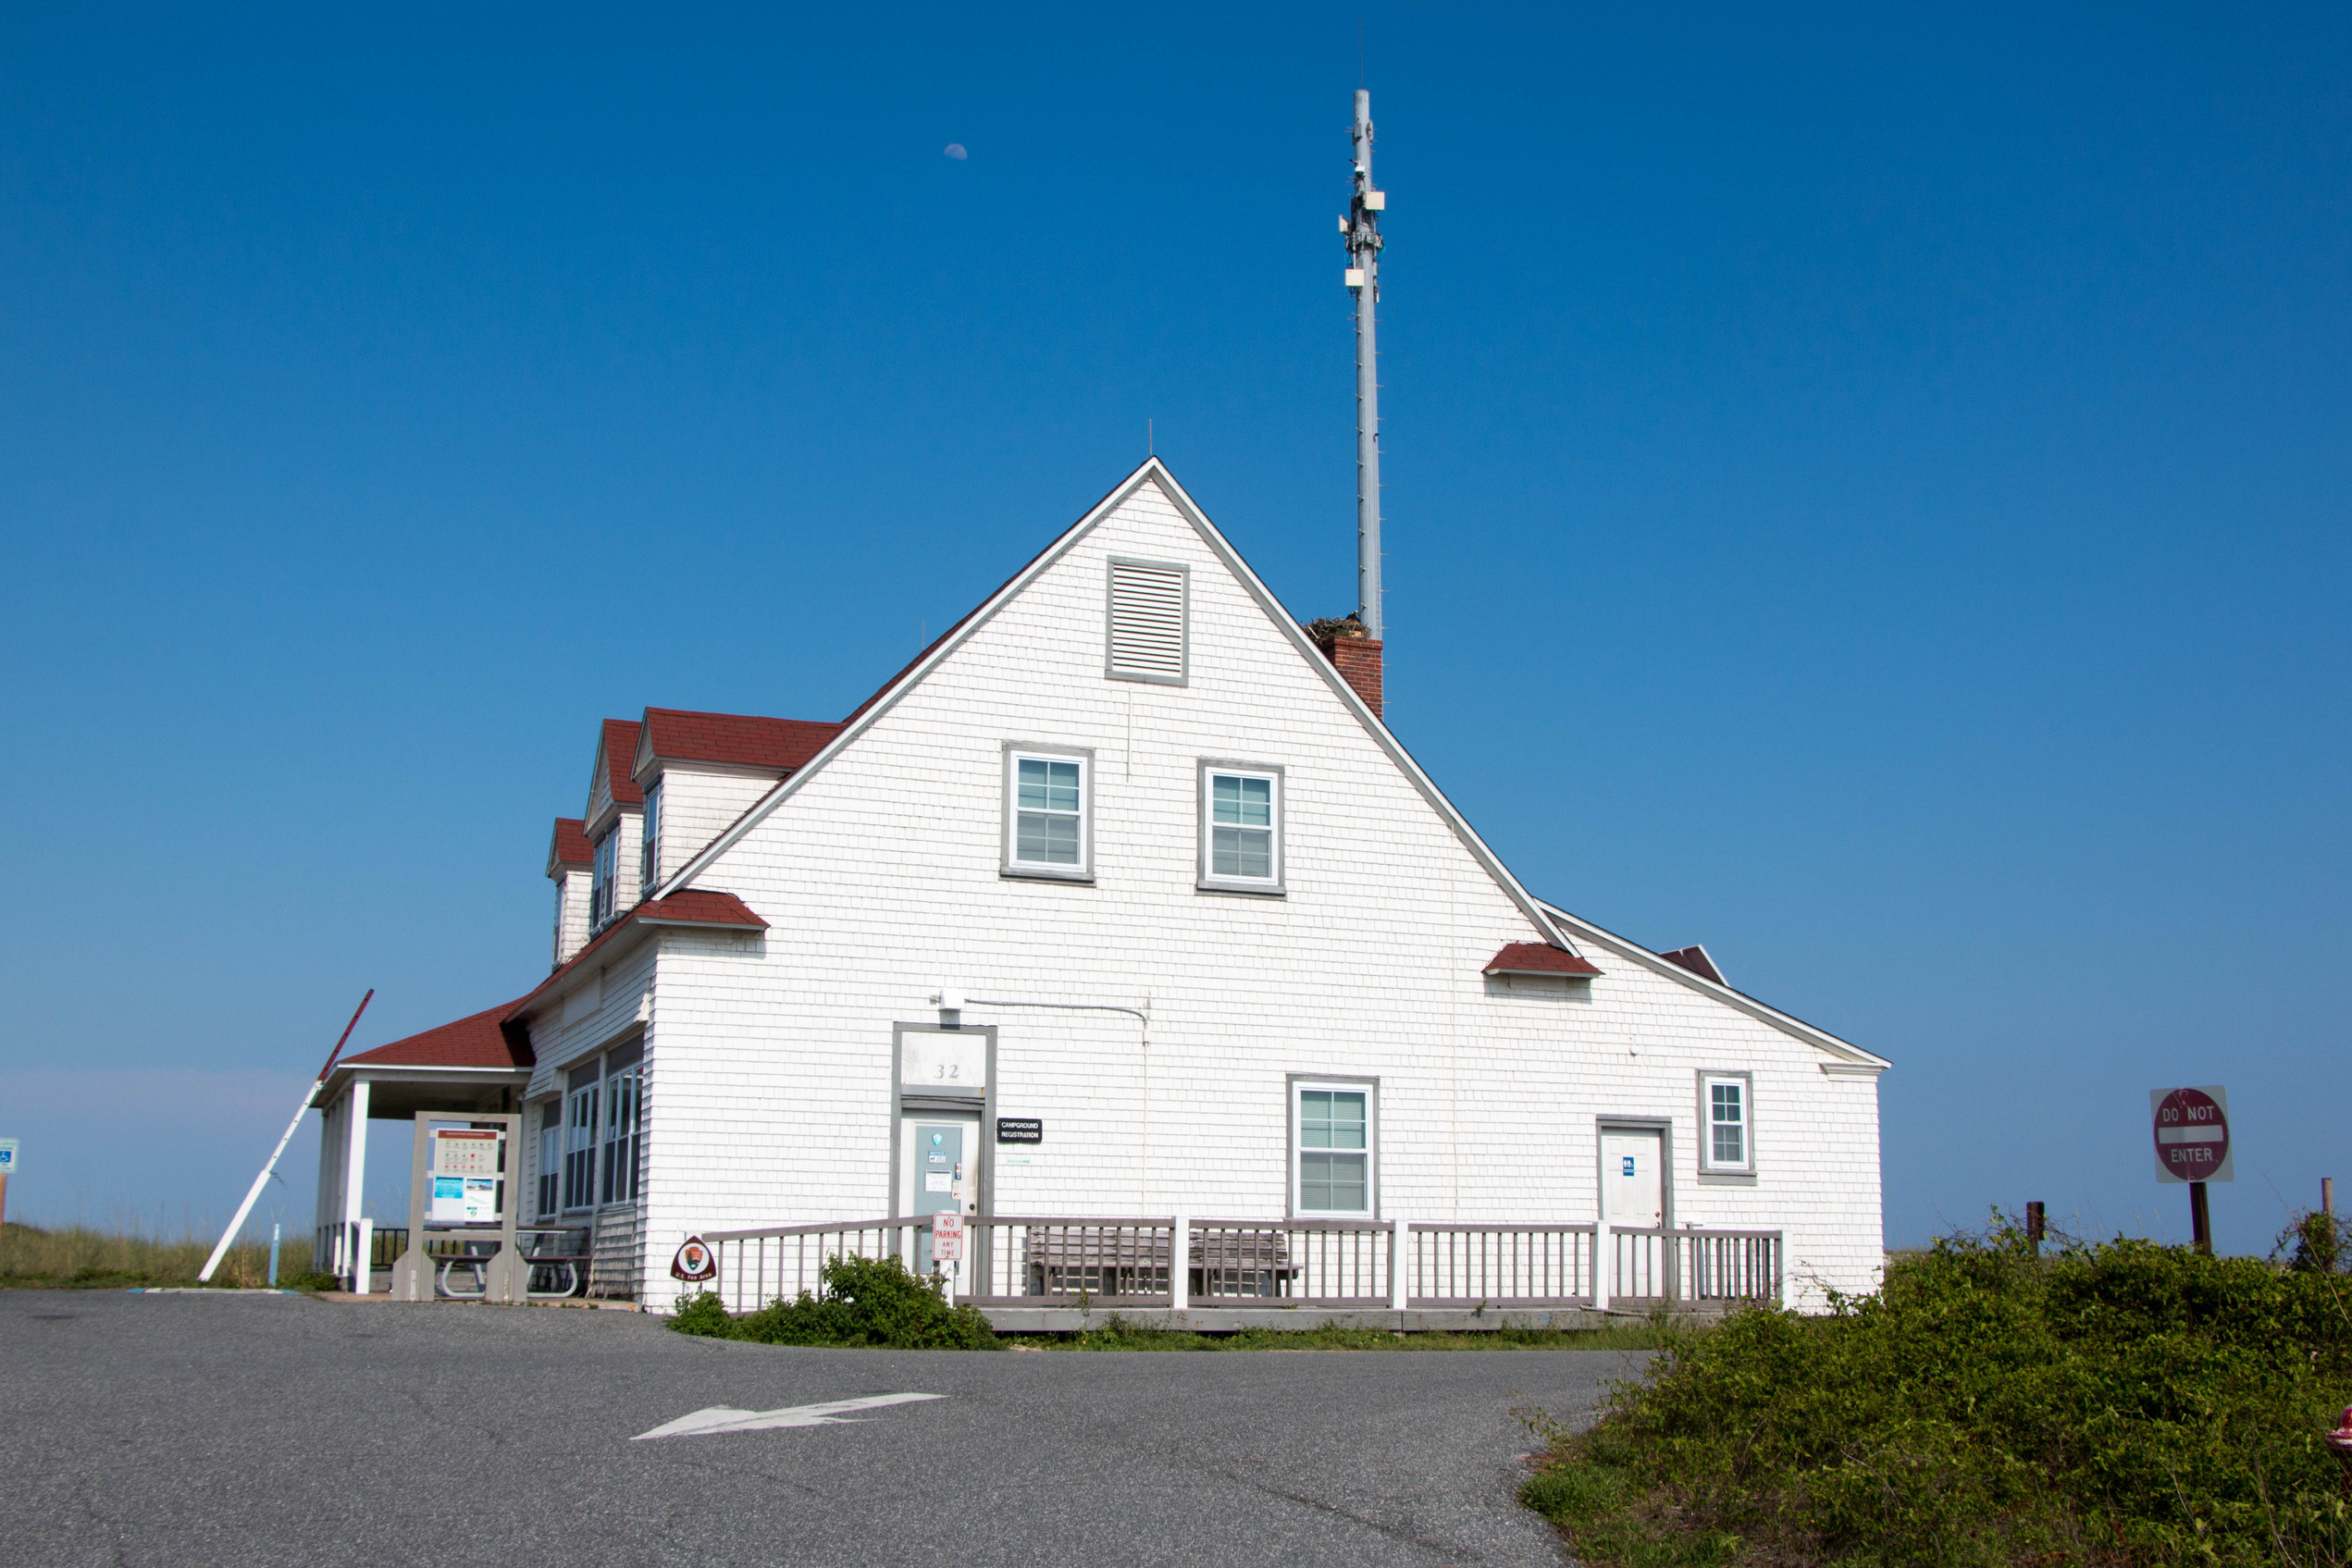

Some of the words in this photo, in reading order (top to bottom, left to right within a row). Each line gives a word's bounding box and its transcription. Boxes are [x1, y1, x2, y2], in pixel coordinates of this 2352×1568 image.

[934, 1064, 959, 1079] 32
[2162, 1108, 2179, 1122] DO
[2187, 1105, 2214, 1121] NOT
[1001, 1121, 1039, 1130] CAMPGROUND
[1001, 1130, 1039, 1139] REGISTRATION
[2171, 1147, 2213, 1163] ENTER
[943, 1218, 955, 1228] NO
[935, 1229, 961, 1240] PARKING
[699, 1272, 712, 1280] Area
